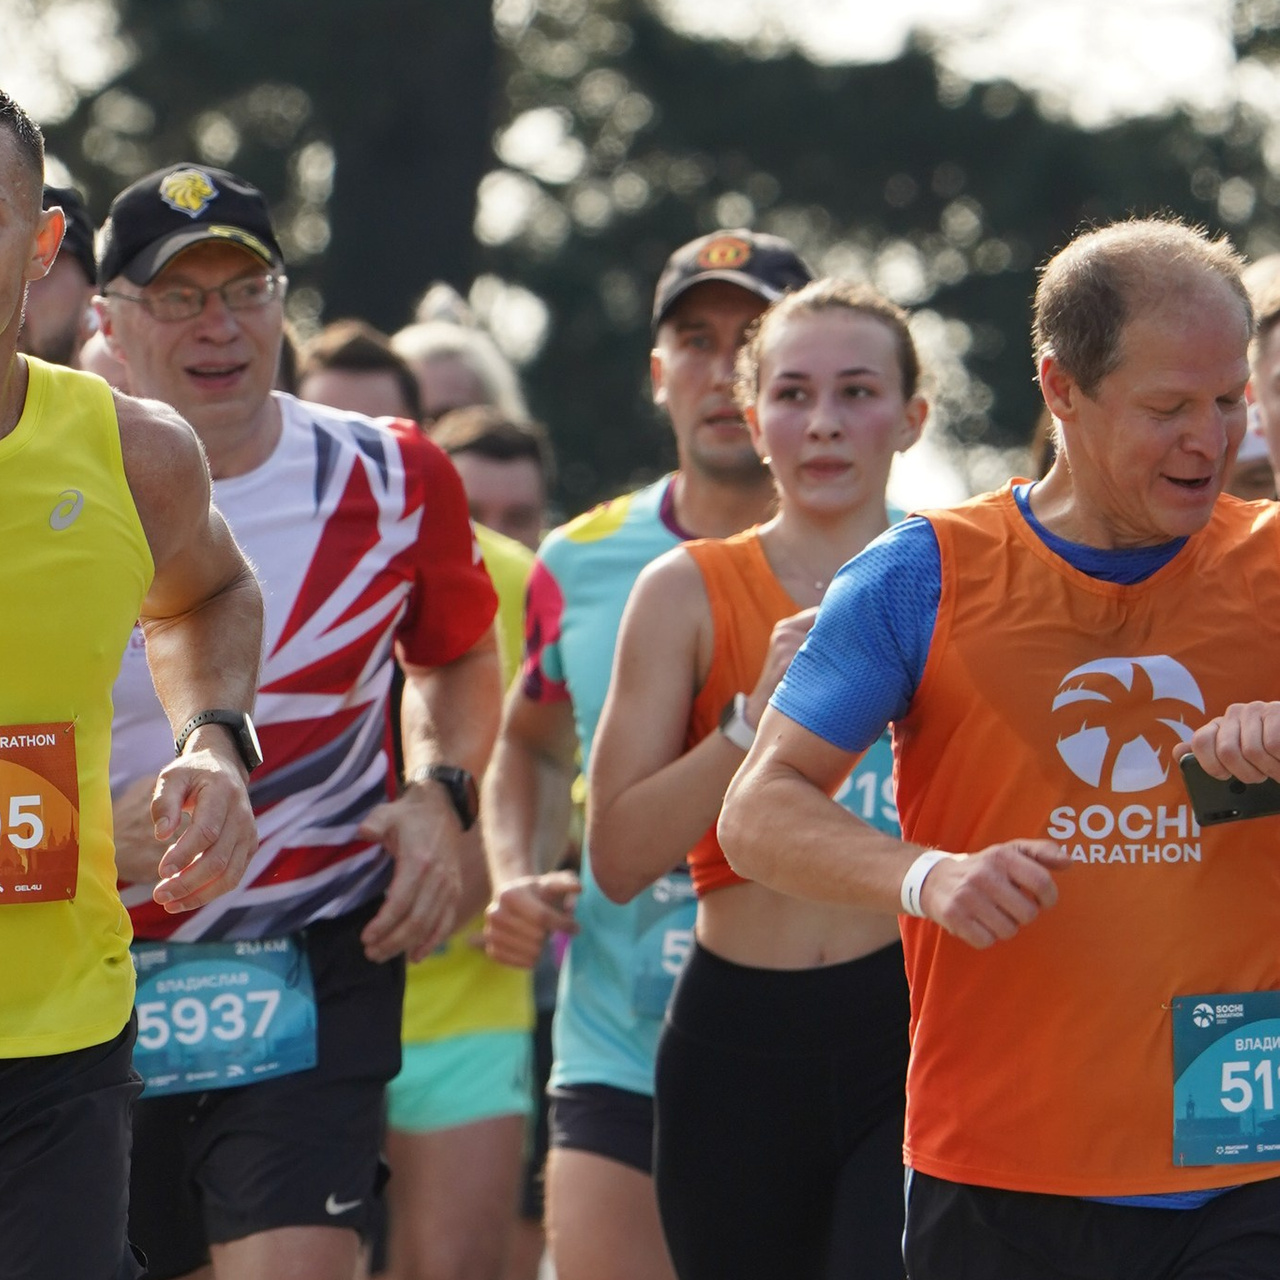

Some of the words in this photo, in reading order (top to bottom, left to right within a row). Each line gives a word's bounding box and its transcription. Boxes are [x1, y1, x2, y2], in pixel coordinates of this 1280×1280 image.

[1046, 803, 1201, 840] SOCHI
[1060, 842, 1202, 864] ARATHON
[14, 884, 43, 892] GEL4U
[156, 971, 250, 994] ВЛАДИСЛАВ
[1215, 1003, 1244, 1013] SOCHI
[136, 989, 281, 1051] 5937
[1220, 1059, 1280, 1113] 51
